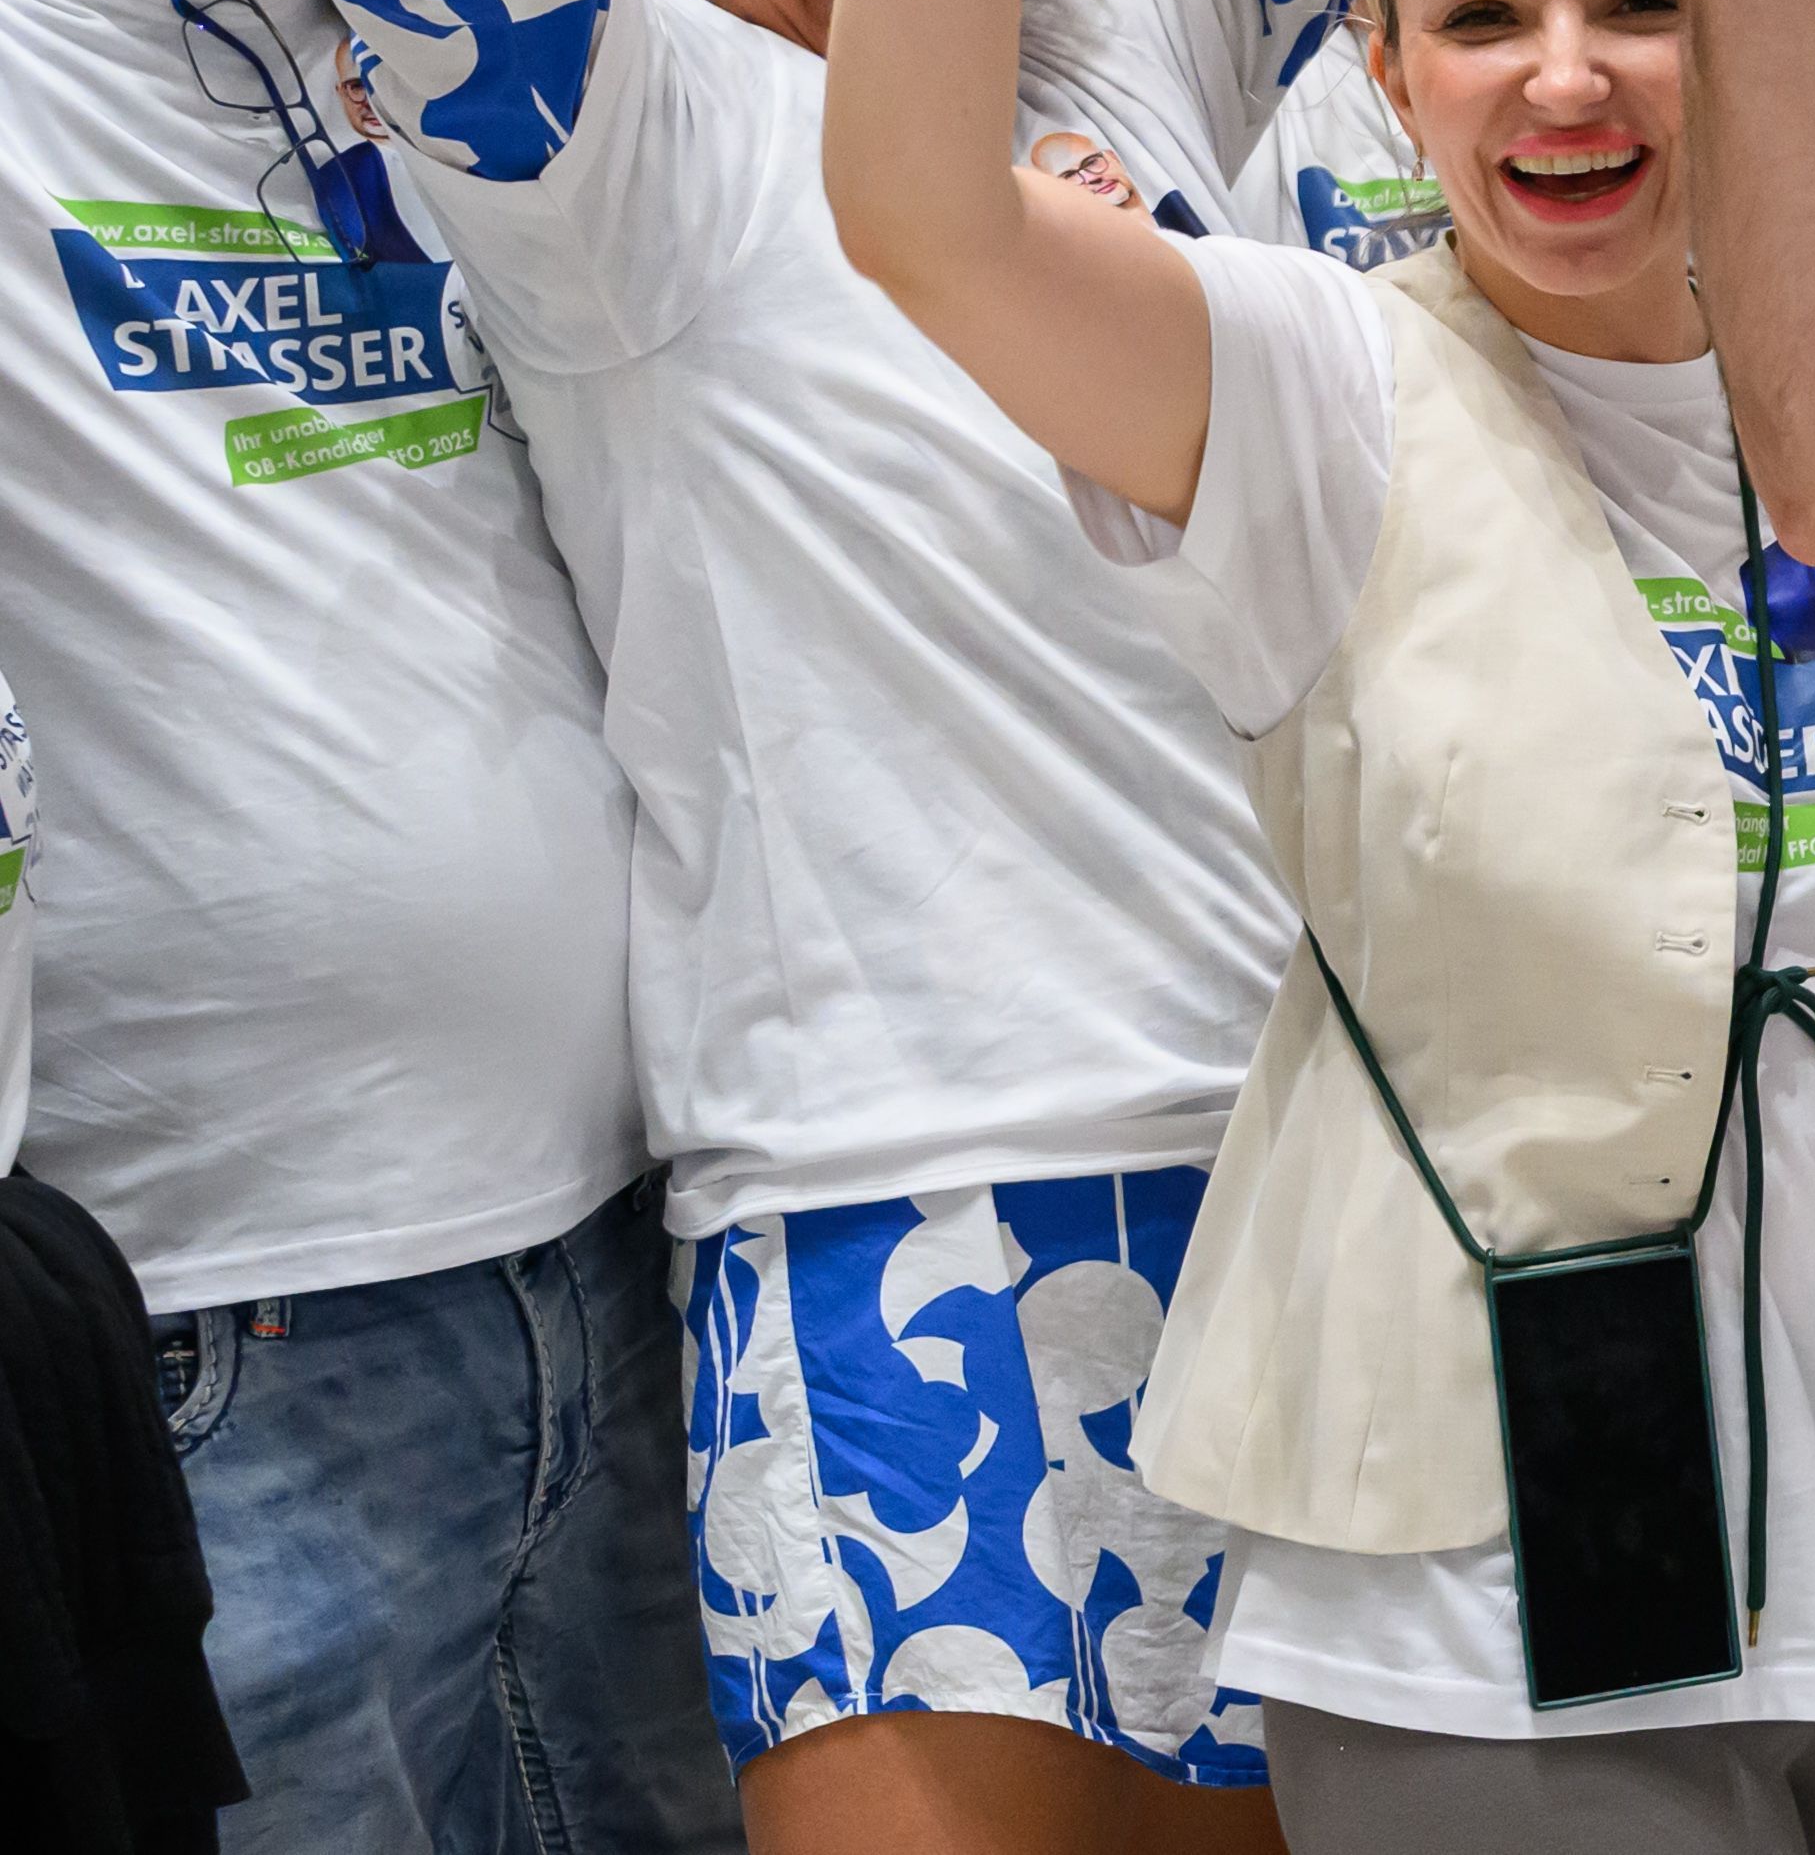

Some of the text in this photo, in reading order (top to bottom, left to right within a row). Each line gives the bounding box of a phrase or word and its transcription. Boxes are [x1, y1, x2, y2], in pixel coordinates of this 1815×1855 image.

[174, 272, 342, 333] AXEL
[233, 433, 262, 454] Ihr
[429, 429, 475, 456] 2025
